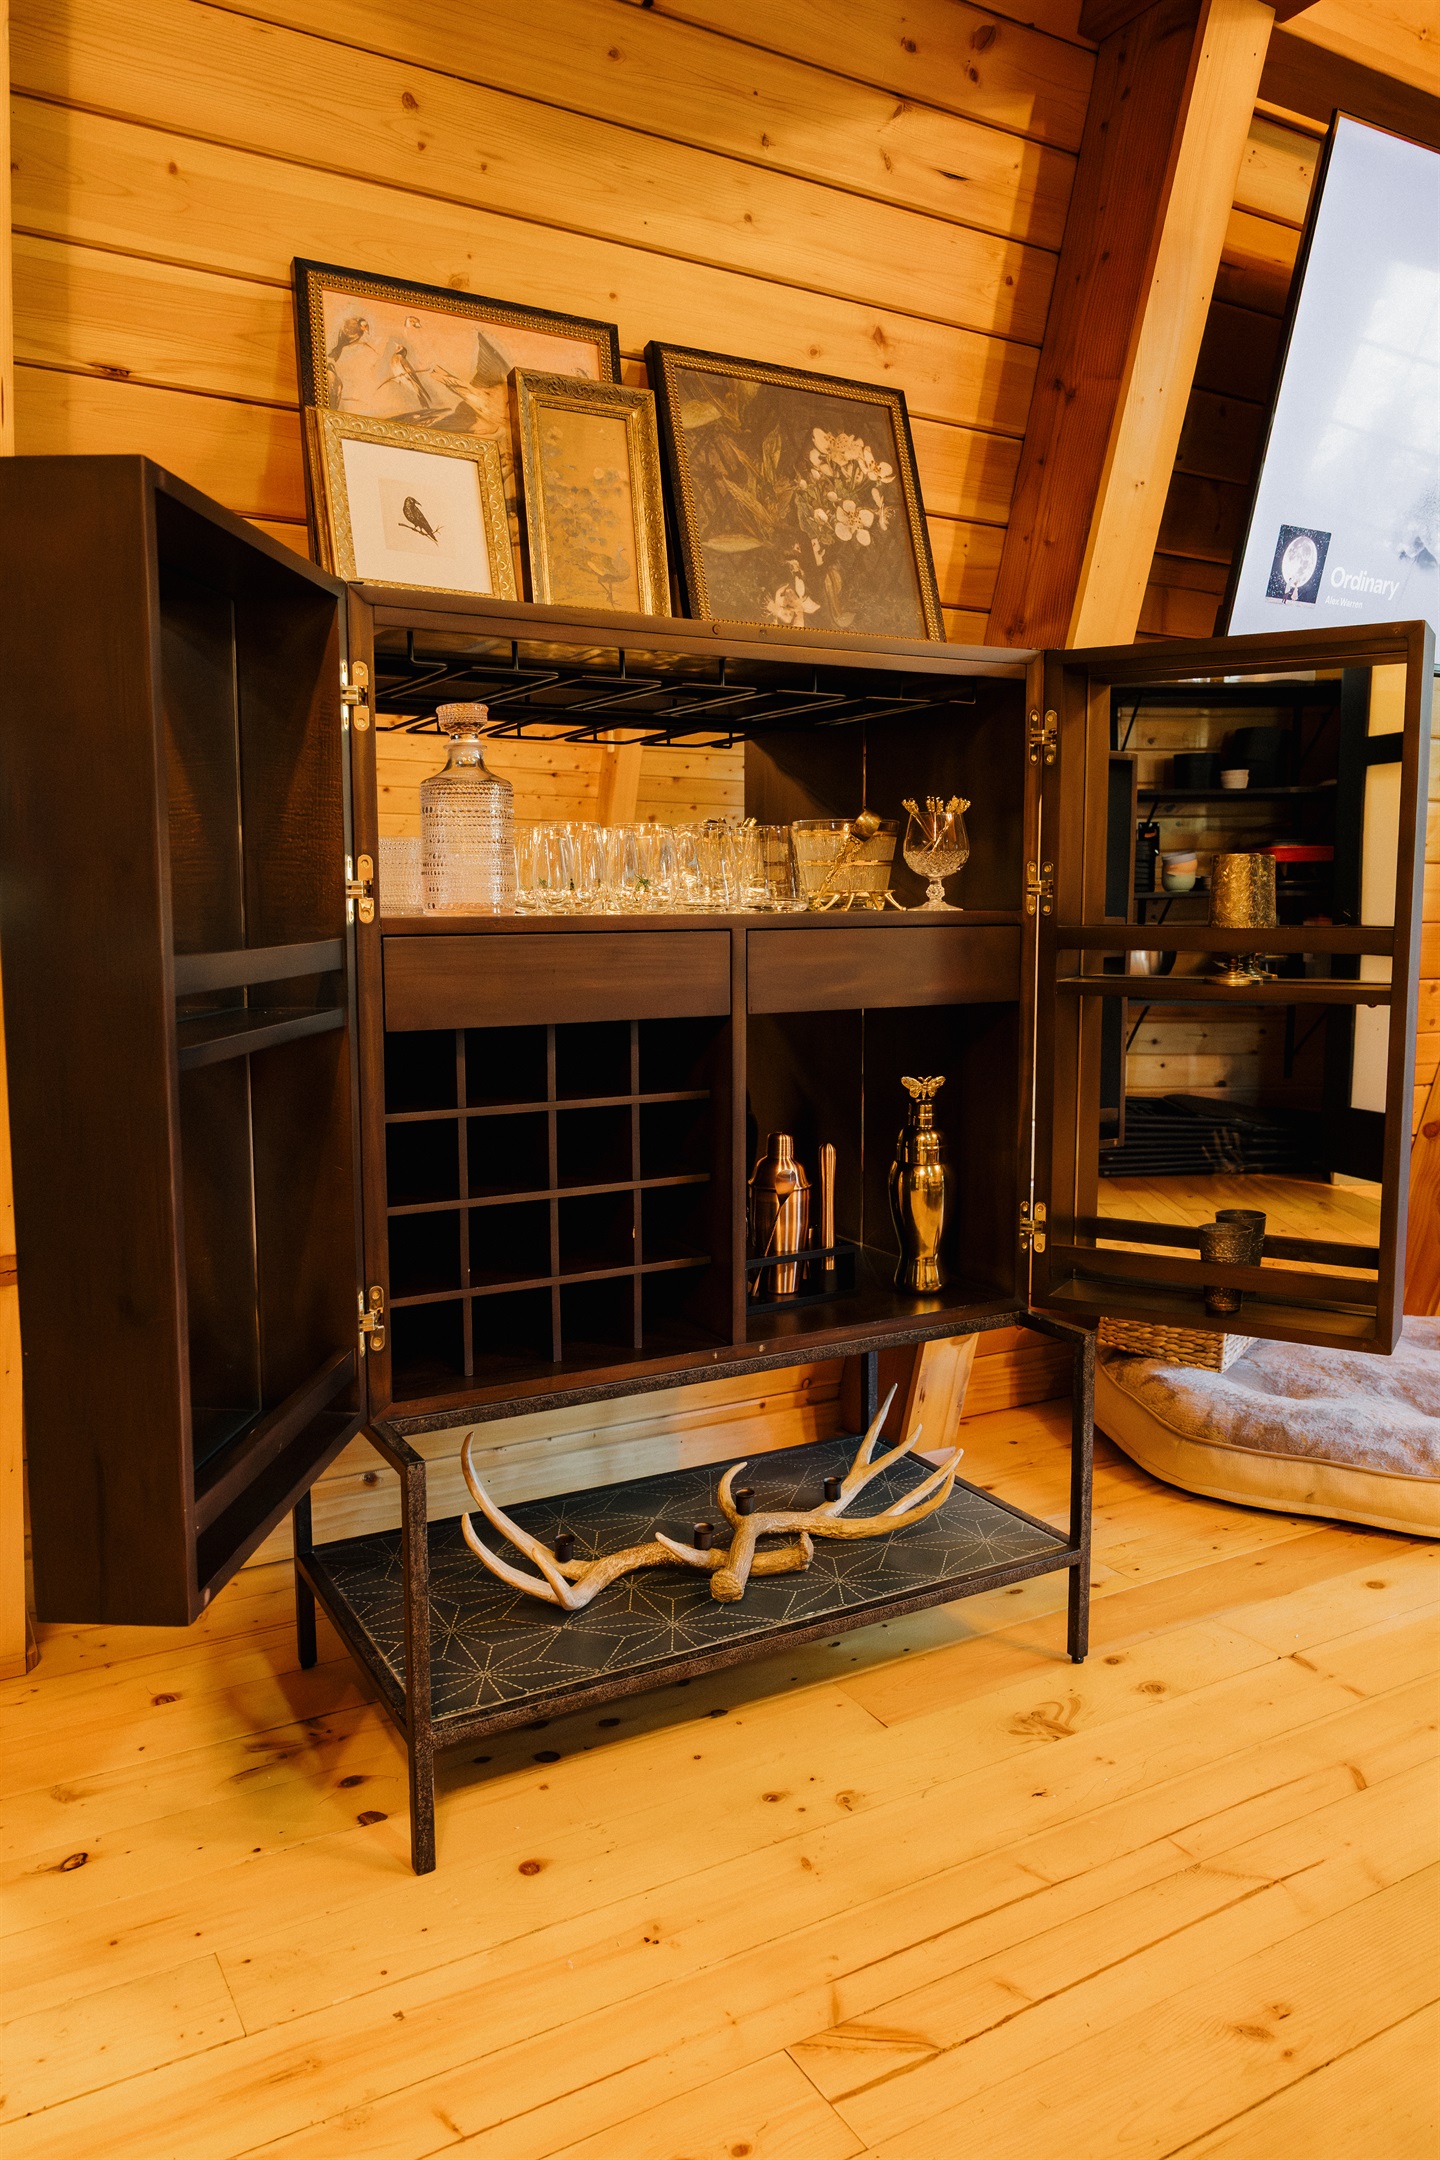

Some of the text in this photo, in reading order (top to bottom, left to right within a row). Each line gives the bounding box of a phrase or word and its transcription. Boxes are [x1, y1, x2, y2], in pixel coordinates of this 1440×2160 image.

[1330, 566, 1400, 600] Ordinary
[1325, 595, 1363, 608] Alex Warren
